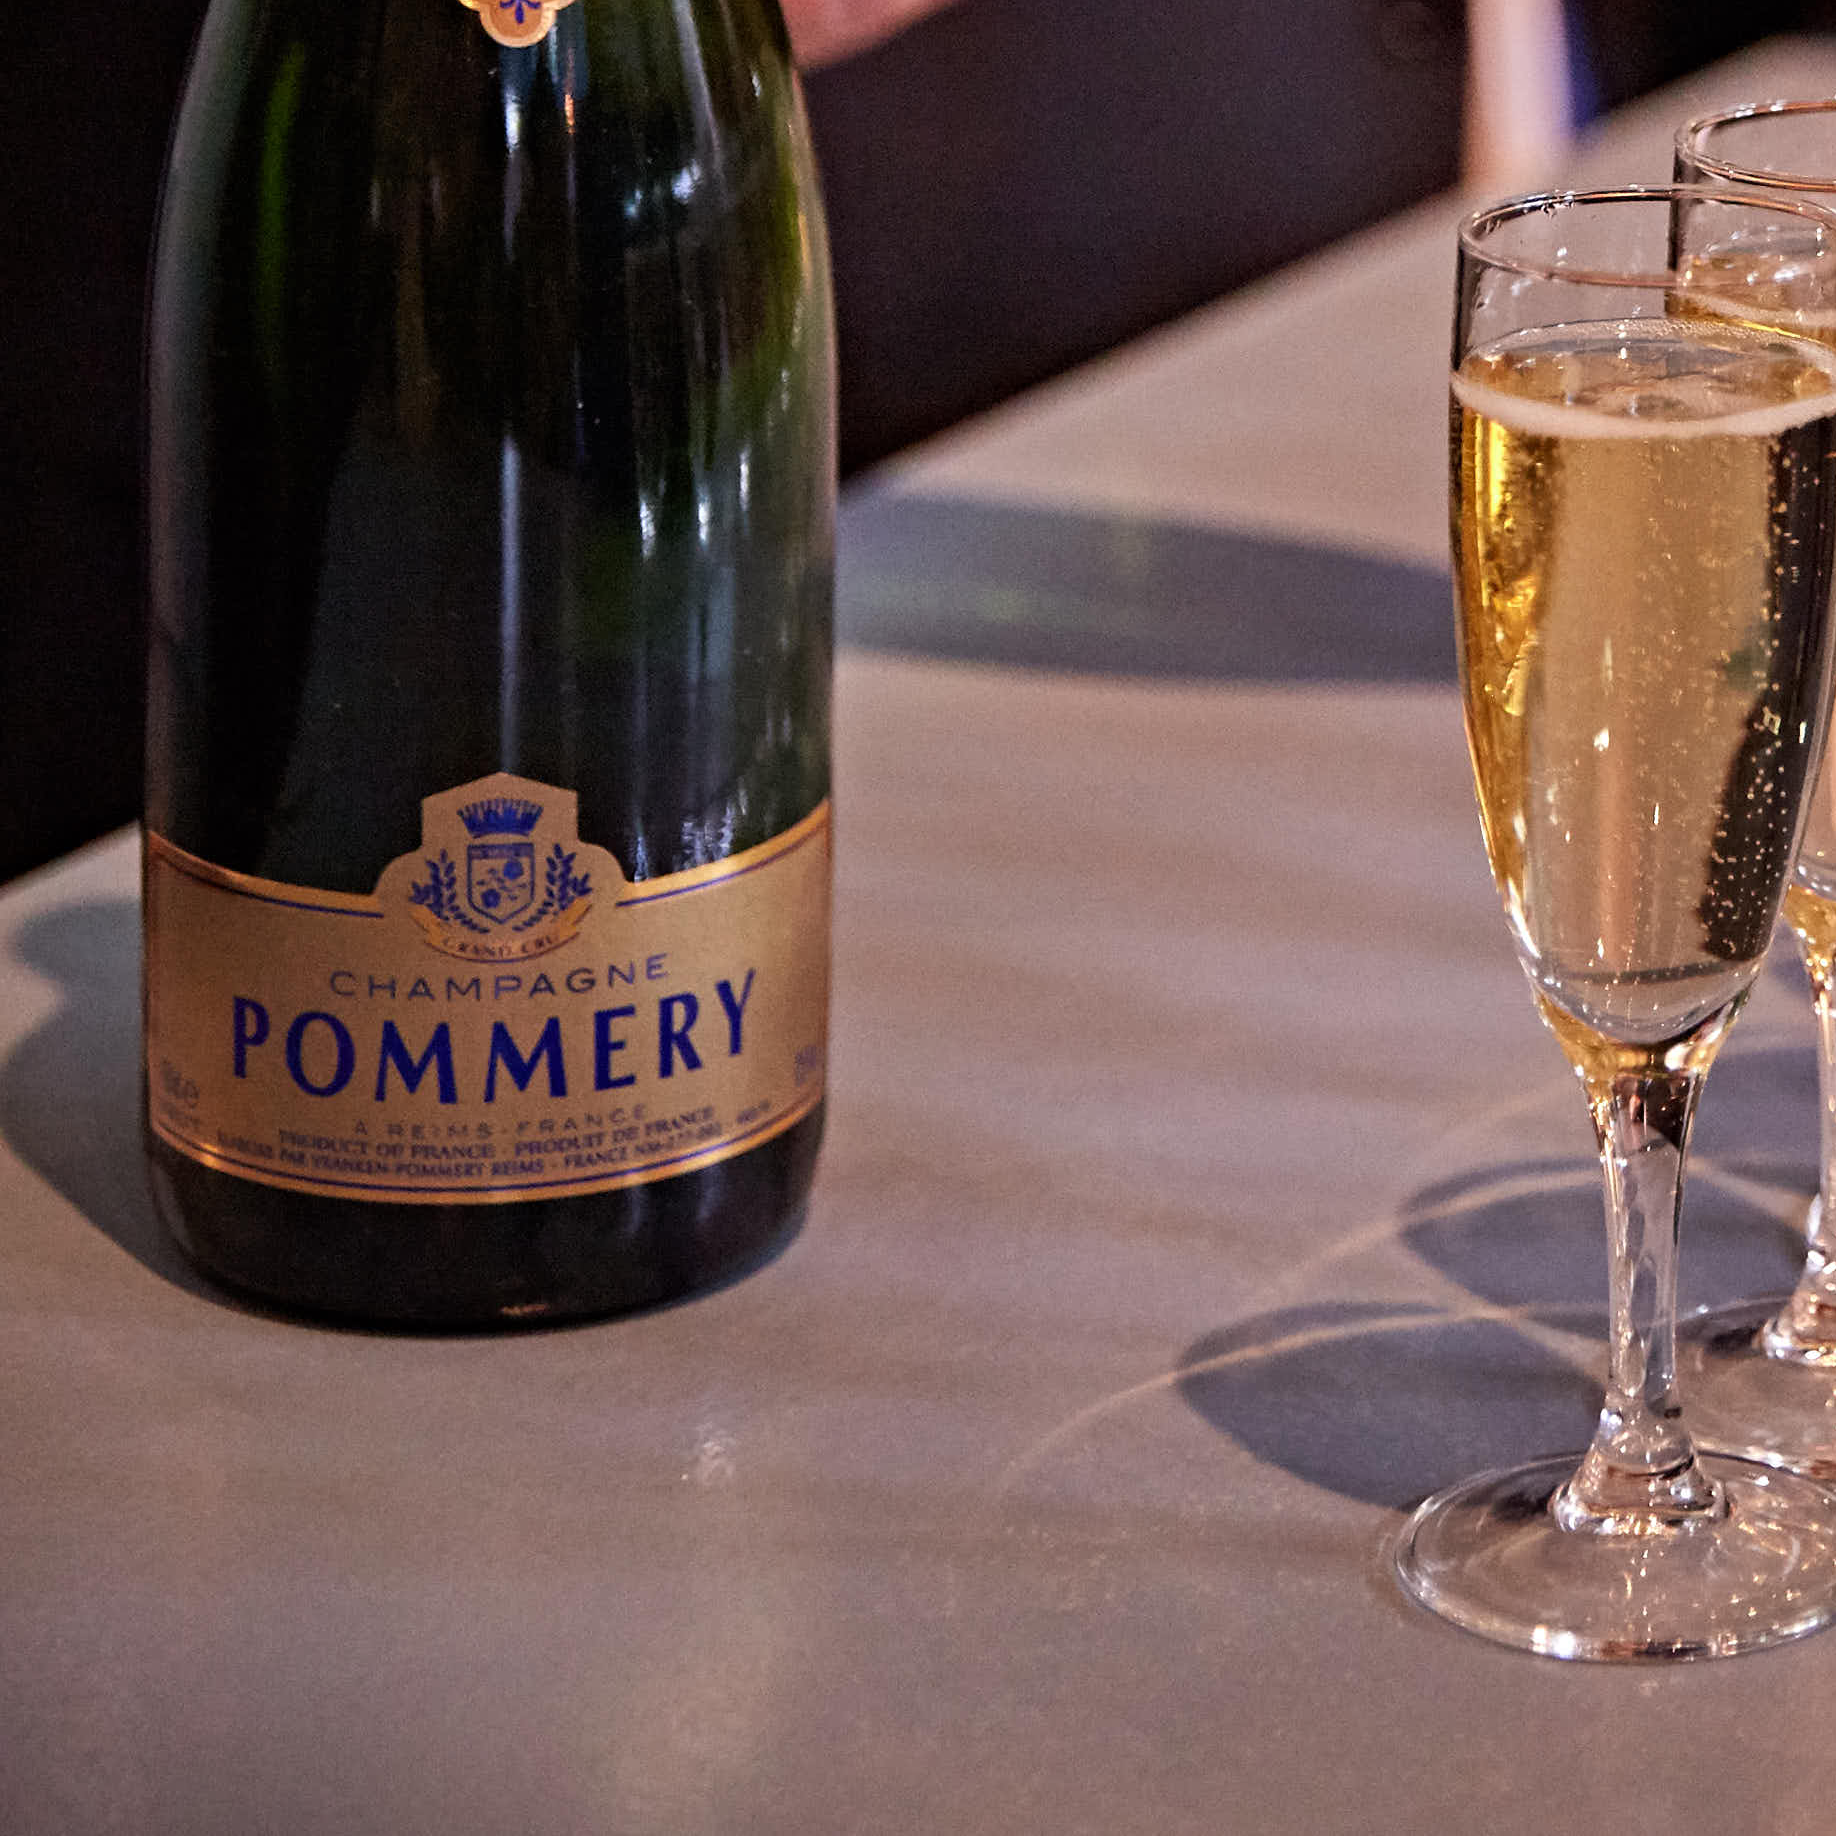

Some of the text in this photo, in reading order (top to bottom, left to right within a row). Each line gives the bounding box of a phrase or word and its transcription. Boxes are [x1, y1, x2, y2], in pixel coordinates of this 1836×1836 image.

[330, 953, 669, 1002] CHAMPAGNE
[233, 968, 757, 1105] POMMERY
[410, 1142, 497, 1161] FRANCE
[514, 1131, 607, 1158] PRODUIT
[611, 1126, 640, 1144] DE
